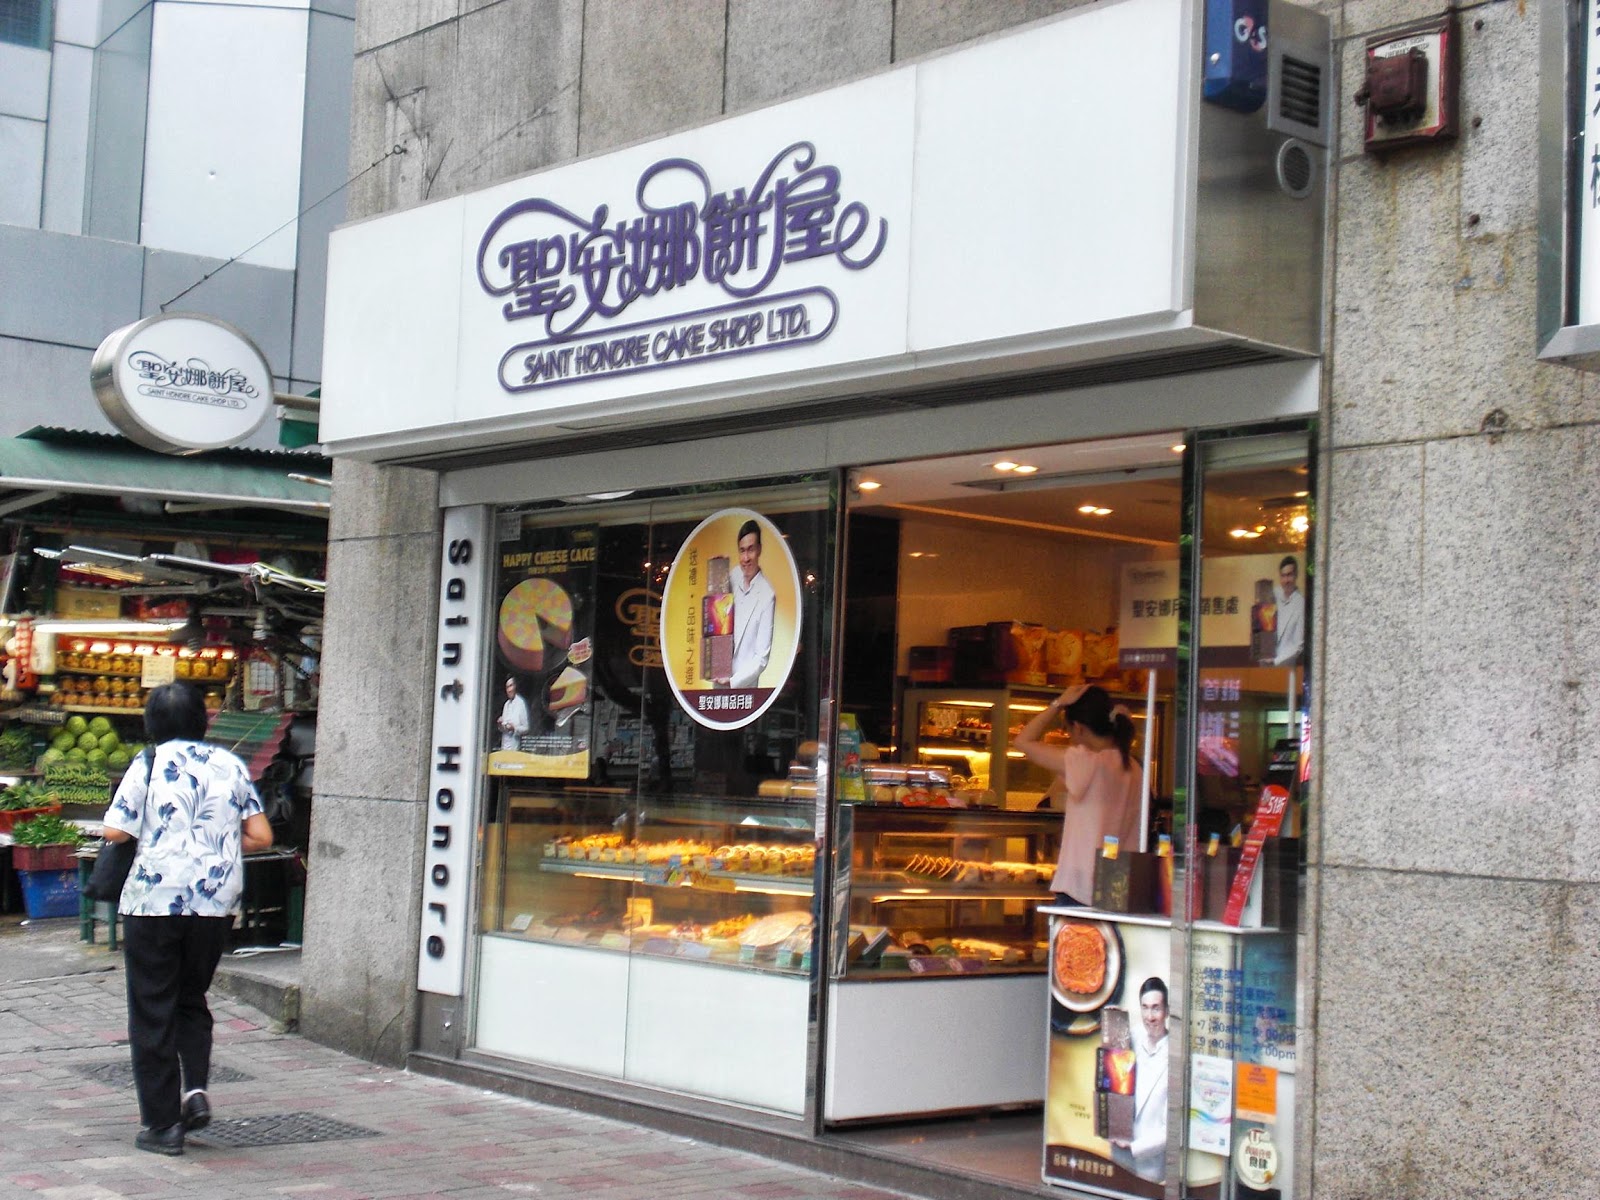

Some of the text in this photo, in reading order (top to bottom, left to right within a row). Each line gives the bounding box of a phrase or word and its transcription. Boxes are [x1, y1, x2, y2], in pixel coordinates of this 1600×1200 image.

[477, 141, 888, 337] 聖安娜餅屋
[522, 350, 571, 383] SAINT
[574, 339, 649, 374] HONORE
[652, 322, 705, 361] CAKE
[706, 311, 762, 353] SHOP
[503, 547, 597, 568] HAPPY CHEESE CAKE
[426, 537, 473, 961] Saint Honore
